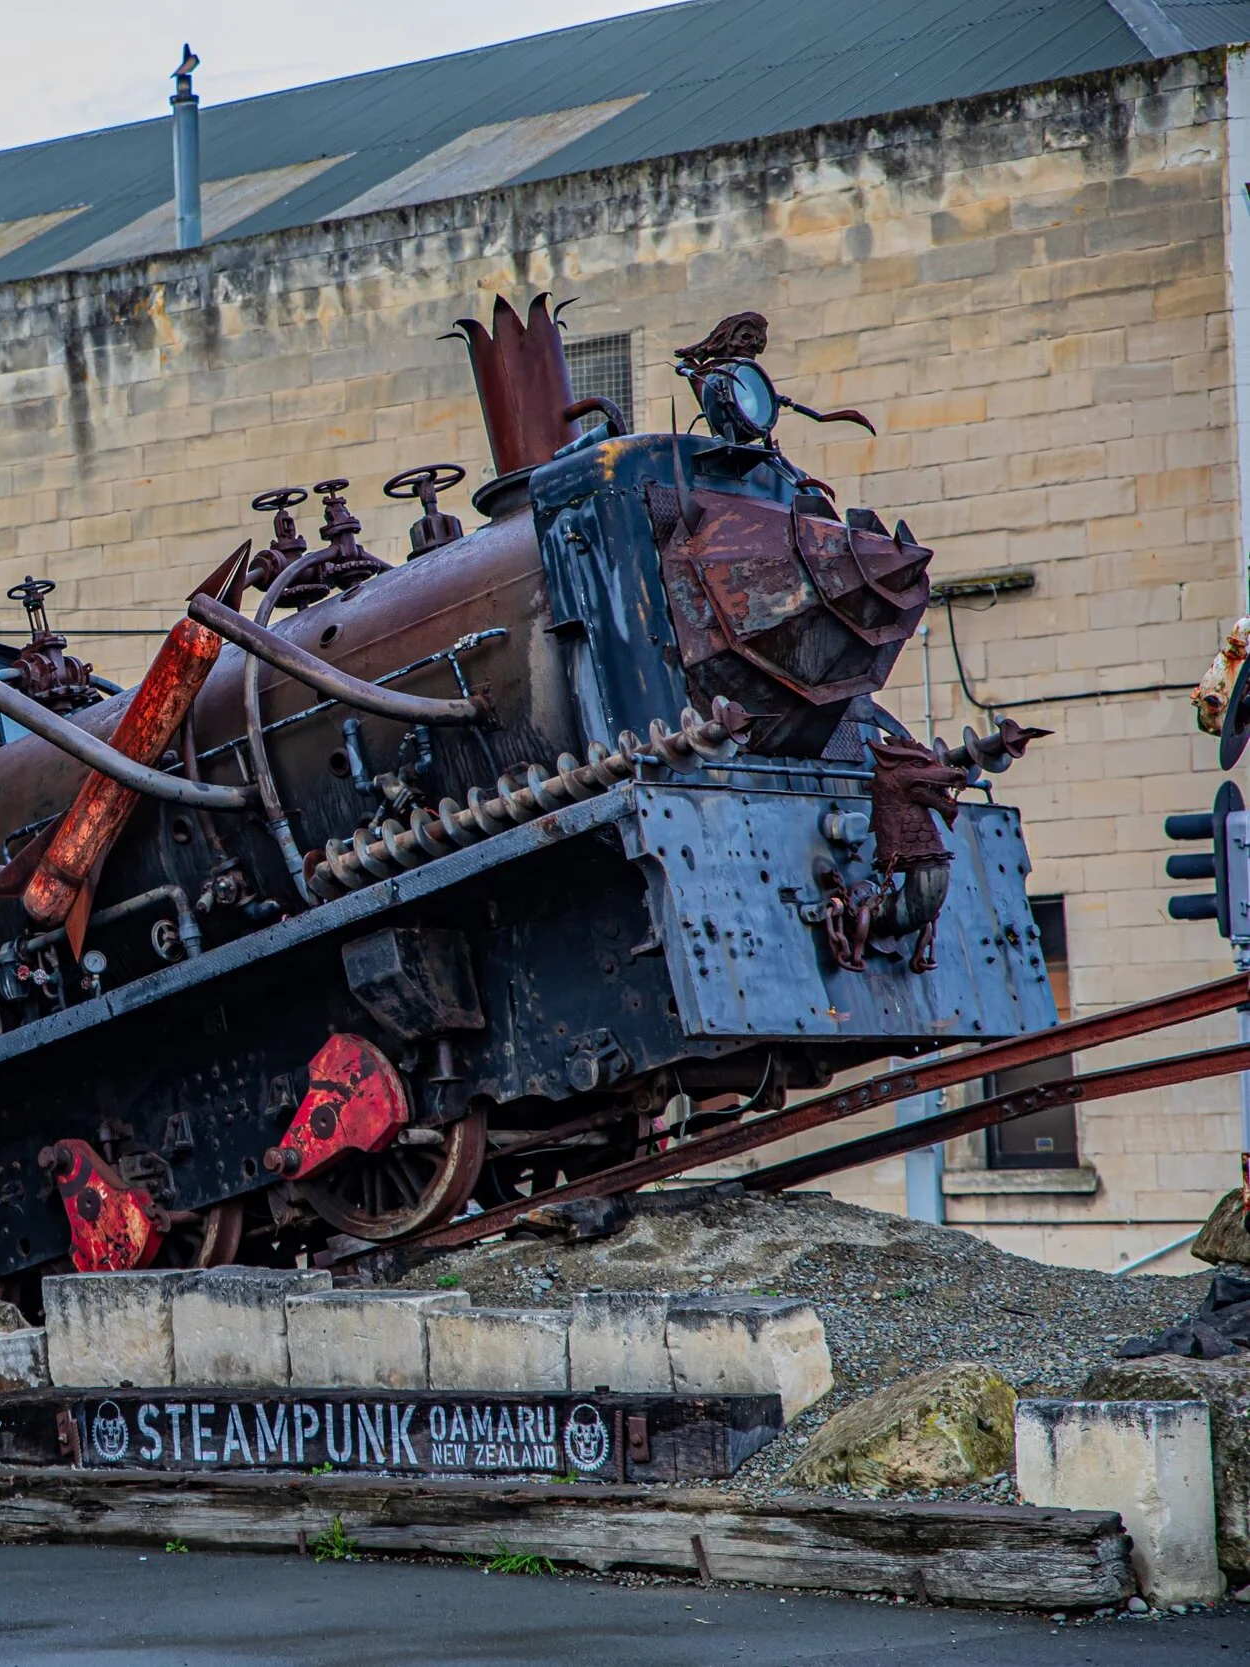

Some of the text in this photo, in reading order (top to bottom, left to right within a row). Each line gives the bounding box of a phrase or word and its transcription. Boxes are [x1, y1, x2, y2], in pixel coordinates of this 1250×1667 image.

[137, 1403, 556, 1465] STEAMPUNK OAMARU
[431, 1443, 557, 1469] NEW ZEALAND
